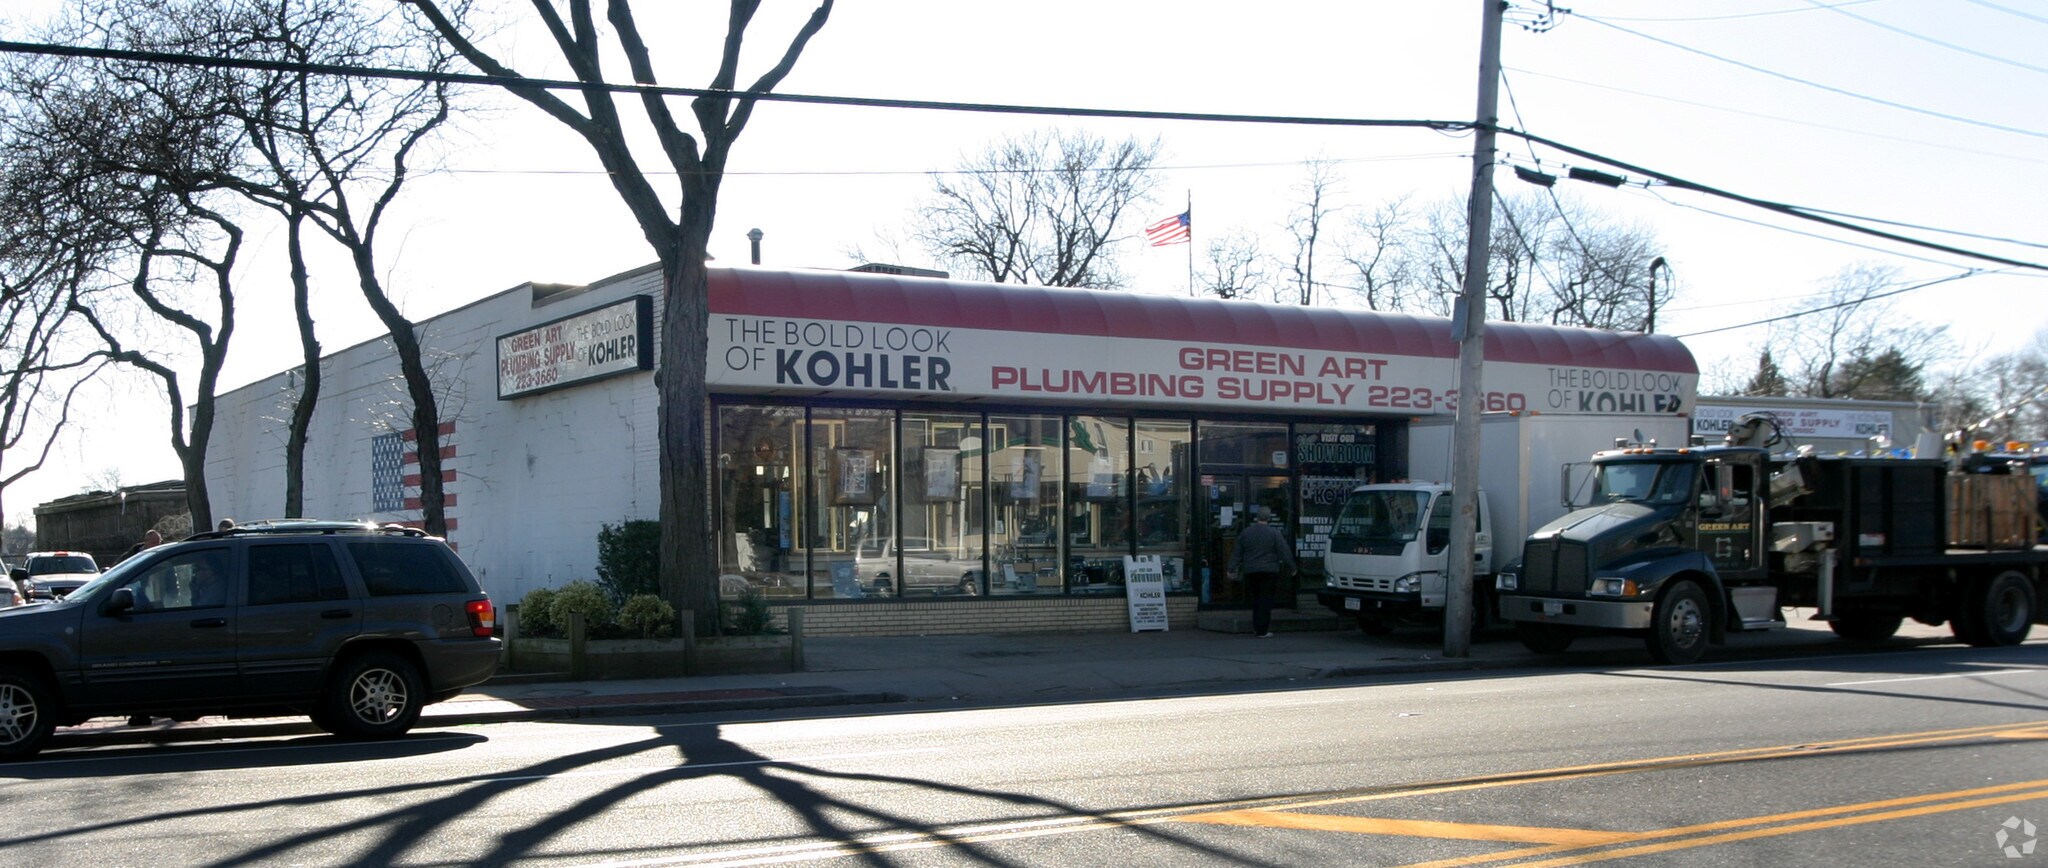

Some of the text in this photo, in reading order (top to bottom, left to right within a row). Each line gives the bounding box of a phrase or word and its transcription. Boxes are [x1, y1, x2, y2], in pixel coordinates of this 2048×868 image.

[511, 325, 562, 352] GREEN ART
[577, 313, 635, 340] THE BOLD LOOK
[725, 318, 951, 353] THE BOLD LOOK
[501, 341, 575, 376] PLUMBING SUPPLY
[578, 334, 635, 366] OF KOHLER
[1179, 347, 1388, 380] GREEN ART
[515, 367, 558, 390] 223-3660
[725, 346, 951, 391] OF KOHLER
[1548, 368, 1682, 392] THE BOLD LOOK
[991, 366, 1526, 411] PLUMBING SUPPLY 223-360
[1548, 389, 1571, 408] OF
[1800, 418, 1840, 428] SUPPLY
[1321, 433, 1356, 443] VISIT OUR
[1297, 443, 1376, 463] SHOWROOM
[1698, 523, 1730, 531] GREEN
